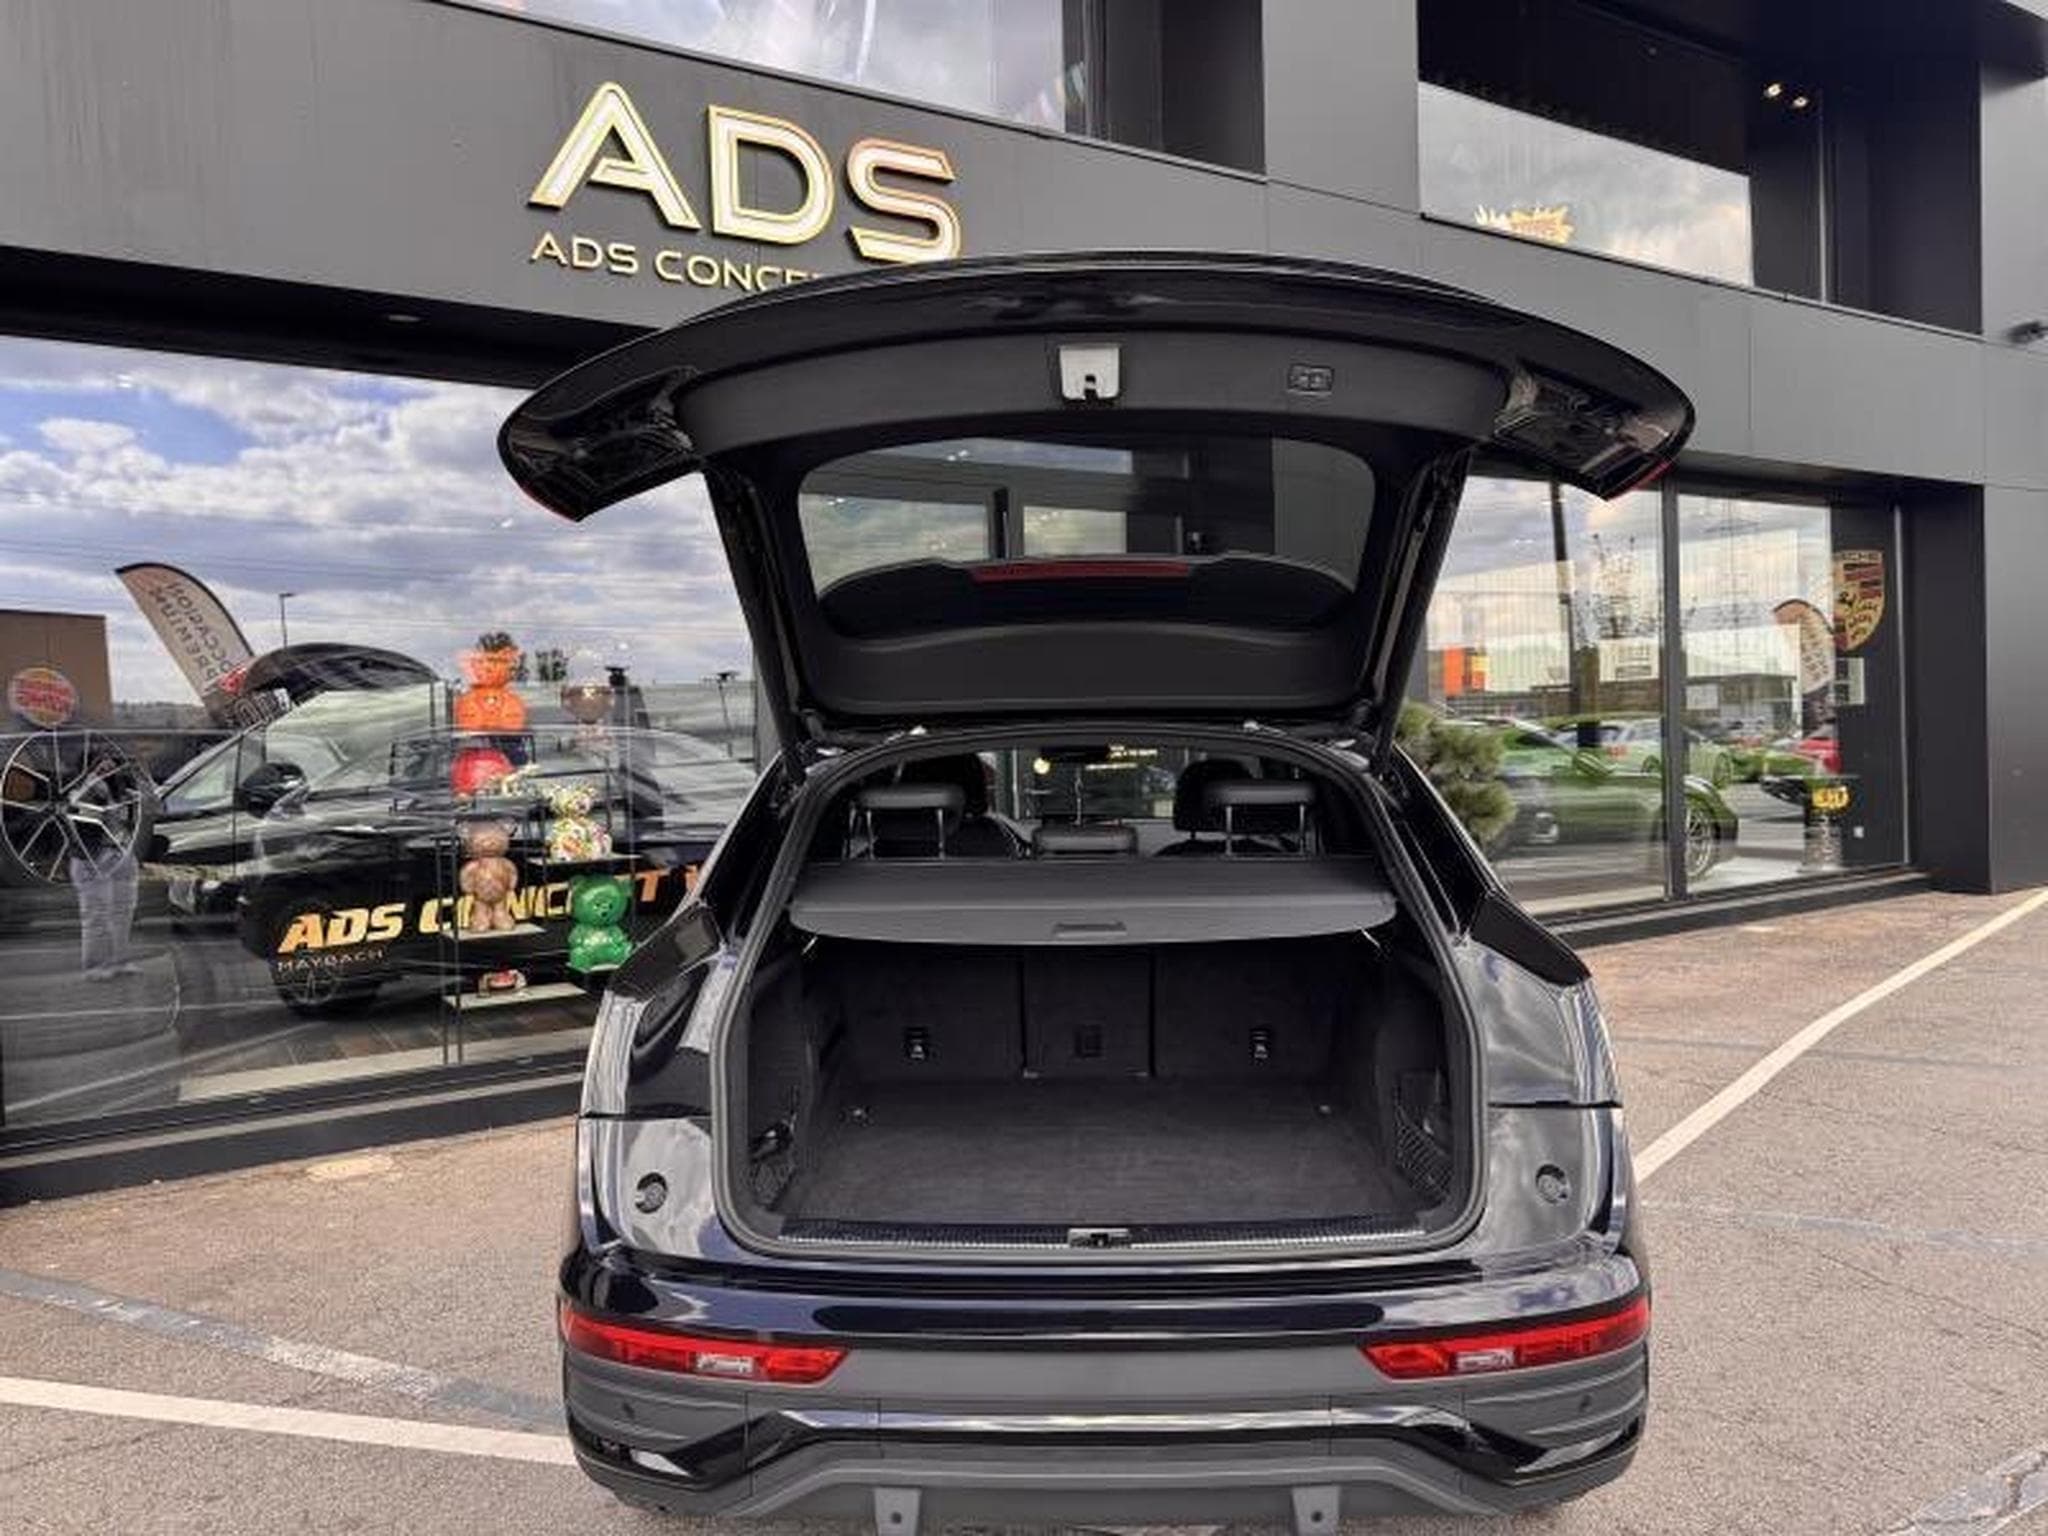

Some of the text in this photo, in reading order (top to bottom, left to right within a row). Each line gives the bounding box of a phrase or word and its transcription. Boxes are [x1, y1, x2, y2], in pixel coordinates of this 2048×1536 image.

[527, 81, 963, 264] ADS
[530, 231, 640, 276] ADS
[278, 903, 406, 954] ADS
